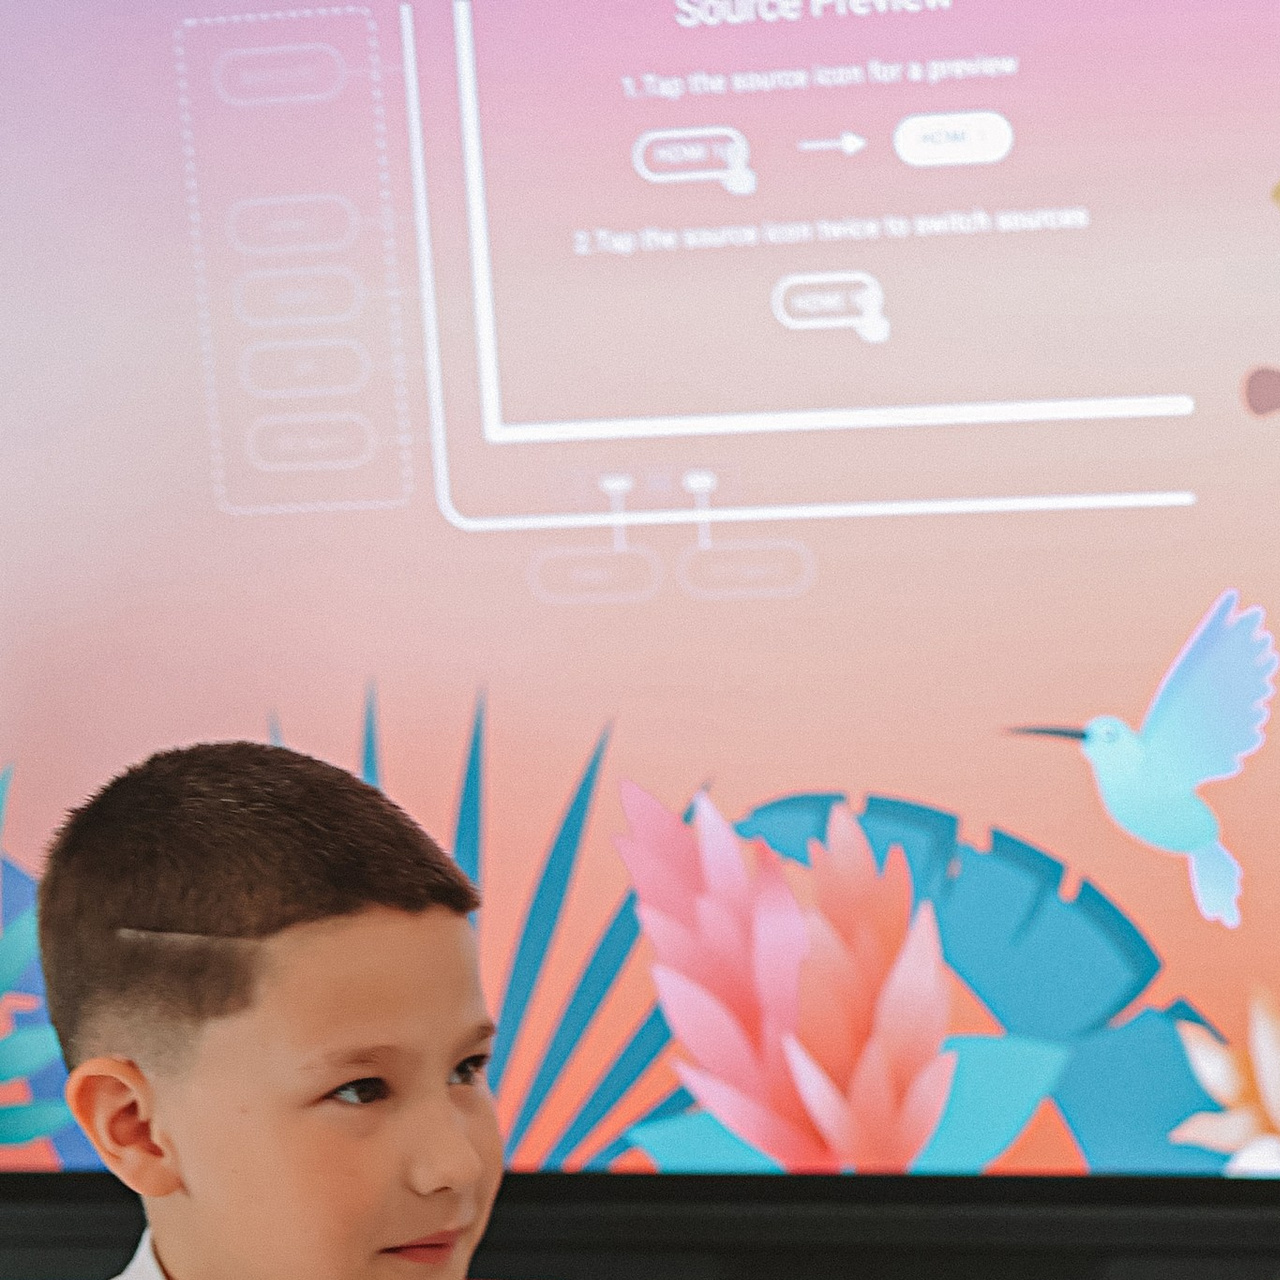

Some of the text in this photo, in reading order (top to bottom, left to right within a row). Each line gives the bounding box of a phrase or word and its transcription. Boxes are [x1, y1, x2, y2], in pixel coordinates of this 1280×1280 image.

[687, 71, 727, 95] the
[730, 69, 808, 93] source
[867, 58, 903, 83] for
[907, 61, 923, 83] a
[927, 55, 1018, 84] preview
[639, 226, 678, 249] the
[684, 225, 758, 247] source
